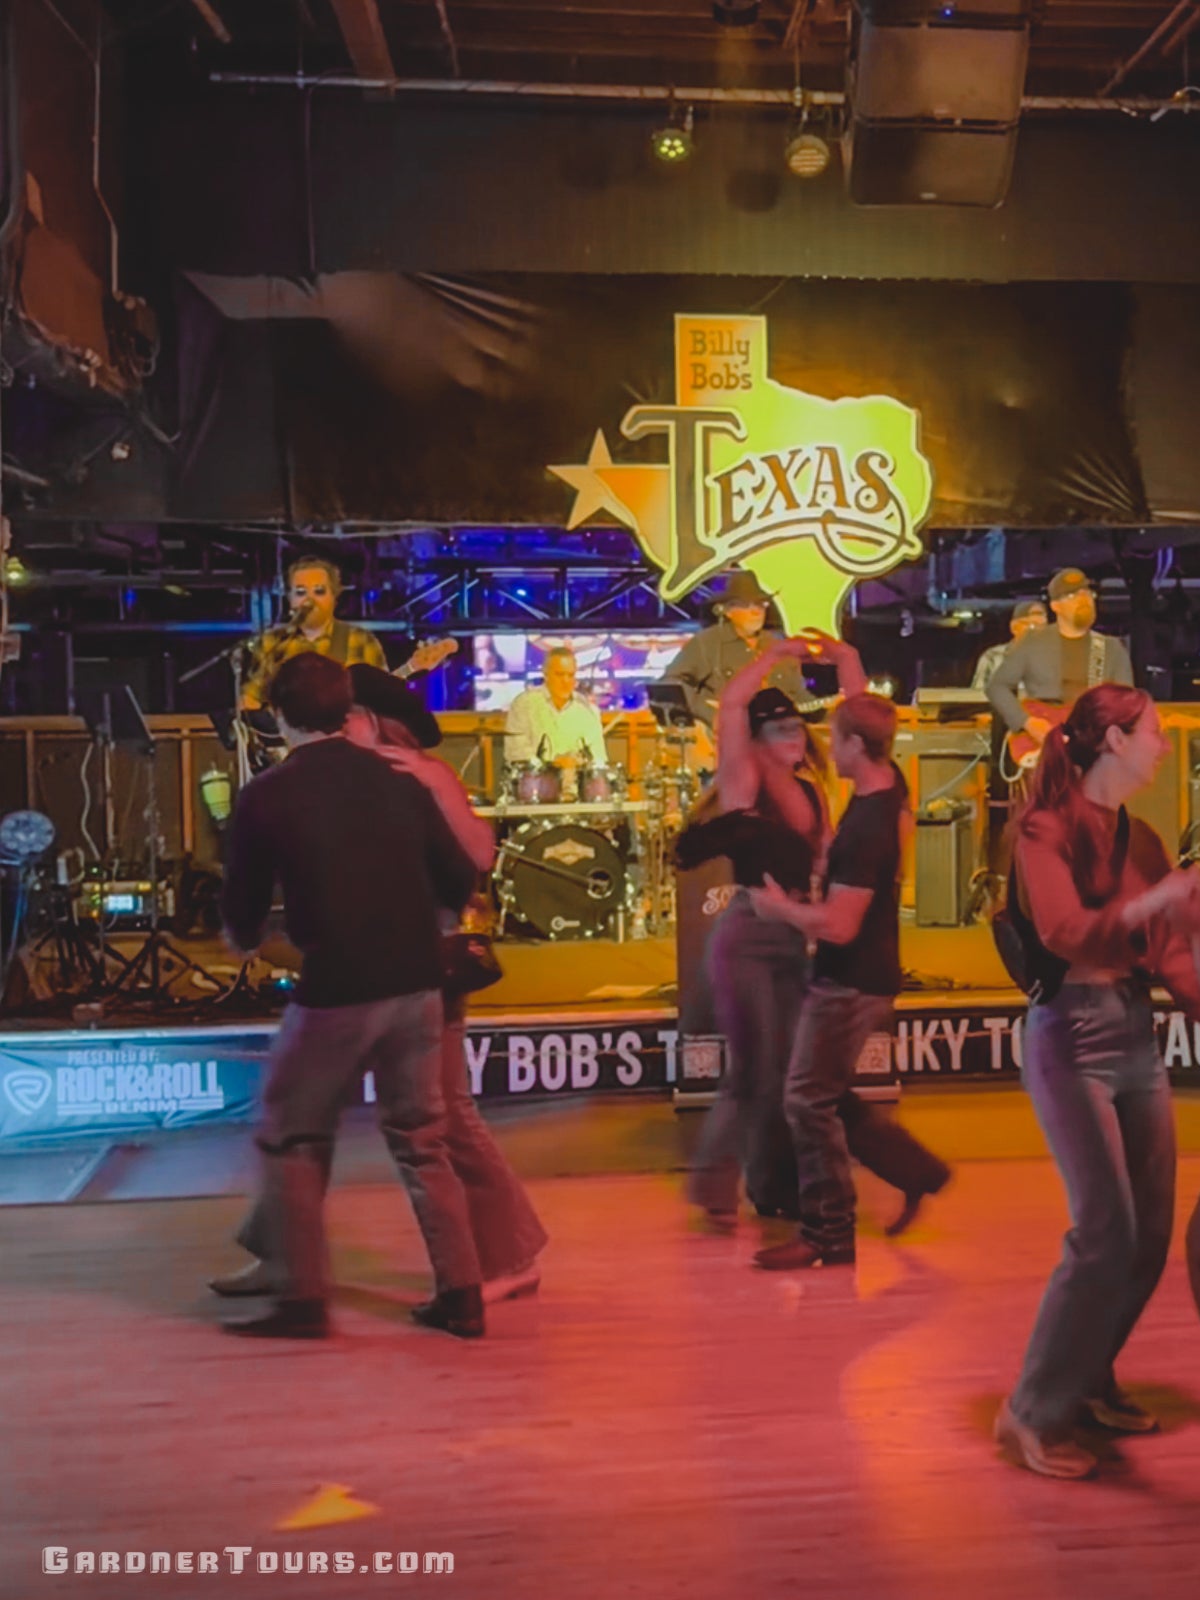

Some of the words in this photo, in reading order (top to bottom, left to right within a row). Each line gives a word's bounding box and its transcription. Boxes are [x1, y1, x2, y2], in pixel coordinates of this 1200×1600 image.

[689, 329, 751, 365] Billy
[689, 362, 753, 391] Bob's
[67, 1047, 137, 1065] PRESENTED
[508, 1030, 643, 1092] BOB'S
[56, 1061, 224, 1103] ROCK&ROLL
[102, 1100, 179, 1114] DENIM
